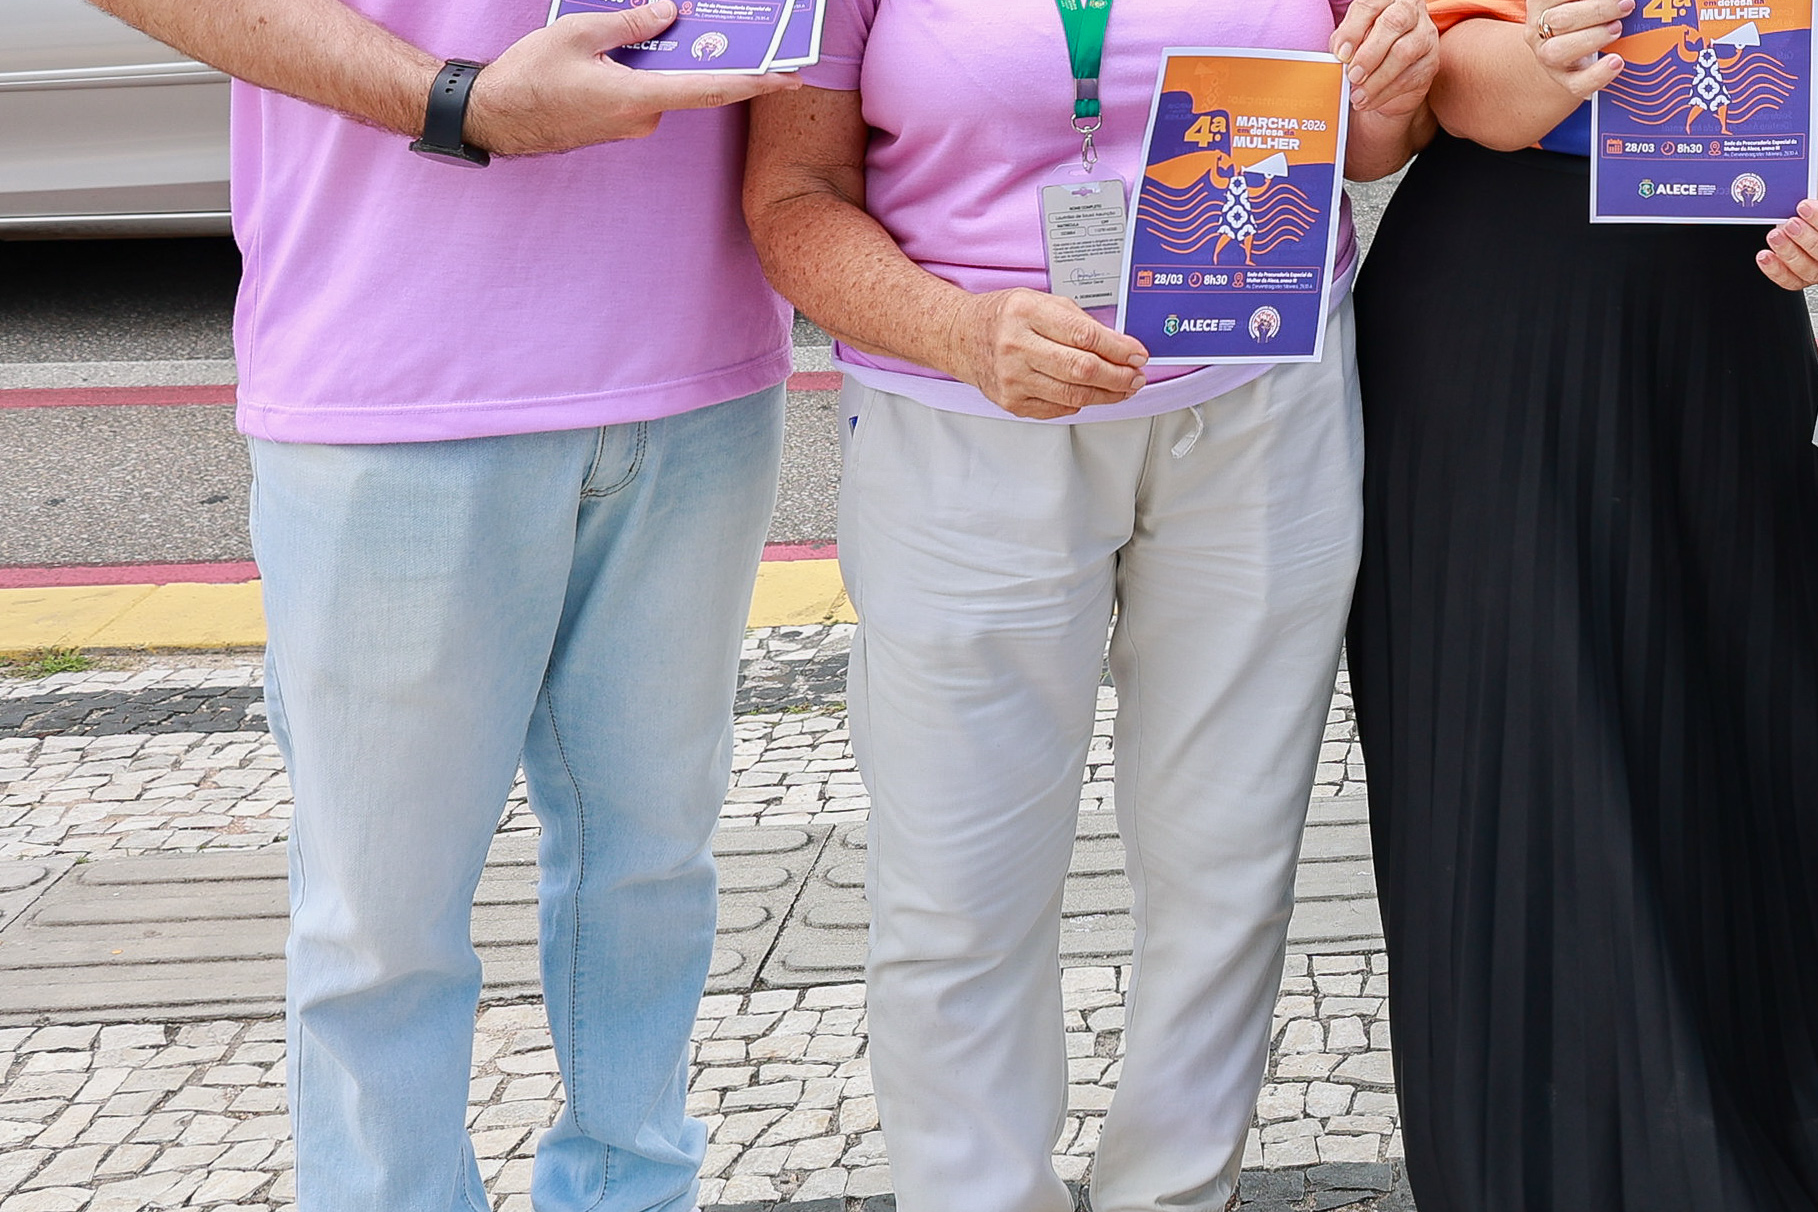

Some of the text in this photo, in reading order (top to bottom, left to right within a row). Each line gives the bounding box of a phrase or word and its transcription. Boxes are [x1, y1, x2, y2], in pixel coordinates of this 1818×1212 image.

[1700, 6, 1771, 20] MULHER
[1236, 116, 1327, 131] MARCHA 2026
[1232, 136, 1300, 150] MULHER
[1624, 142, 1655, 153] 28/03
[1677, 143, 1703, 154] 8h30
[1656, 184, 1697, 195] ALECE
[1154, 273, 1183, 285] 28/03
[1203, 274, 1228, 285] 8h30
[1179, 319, 1218, 332] ALECE
